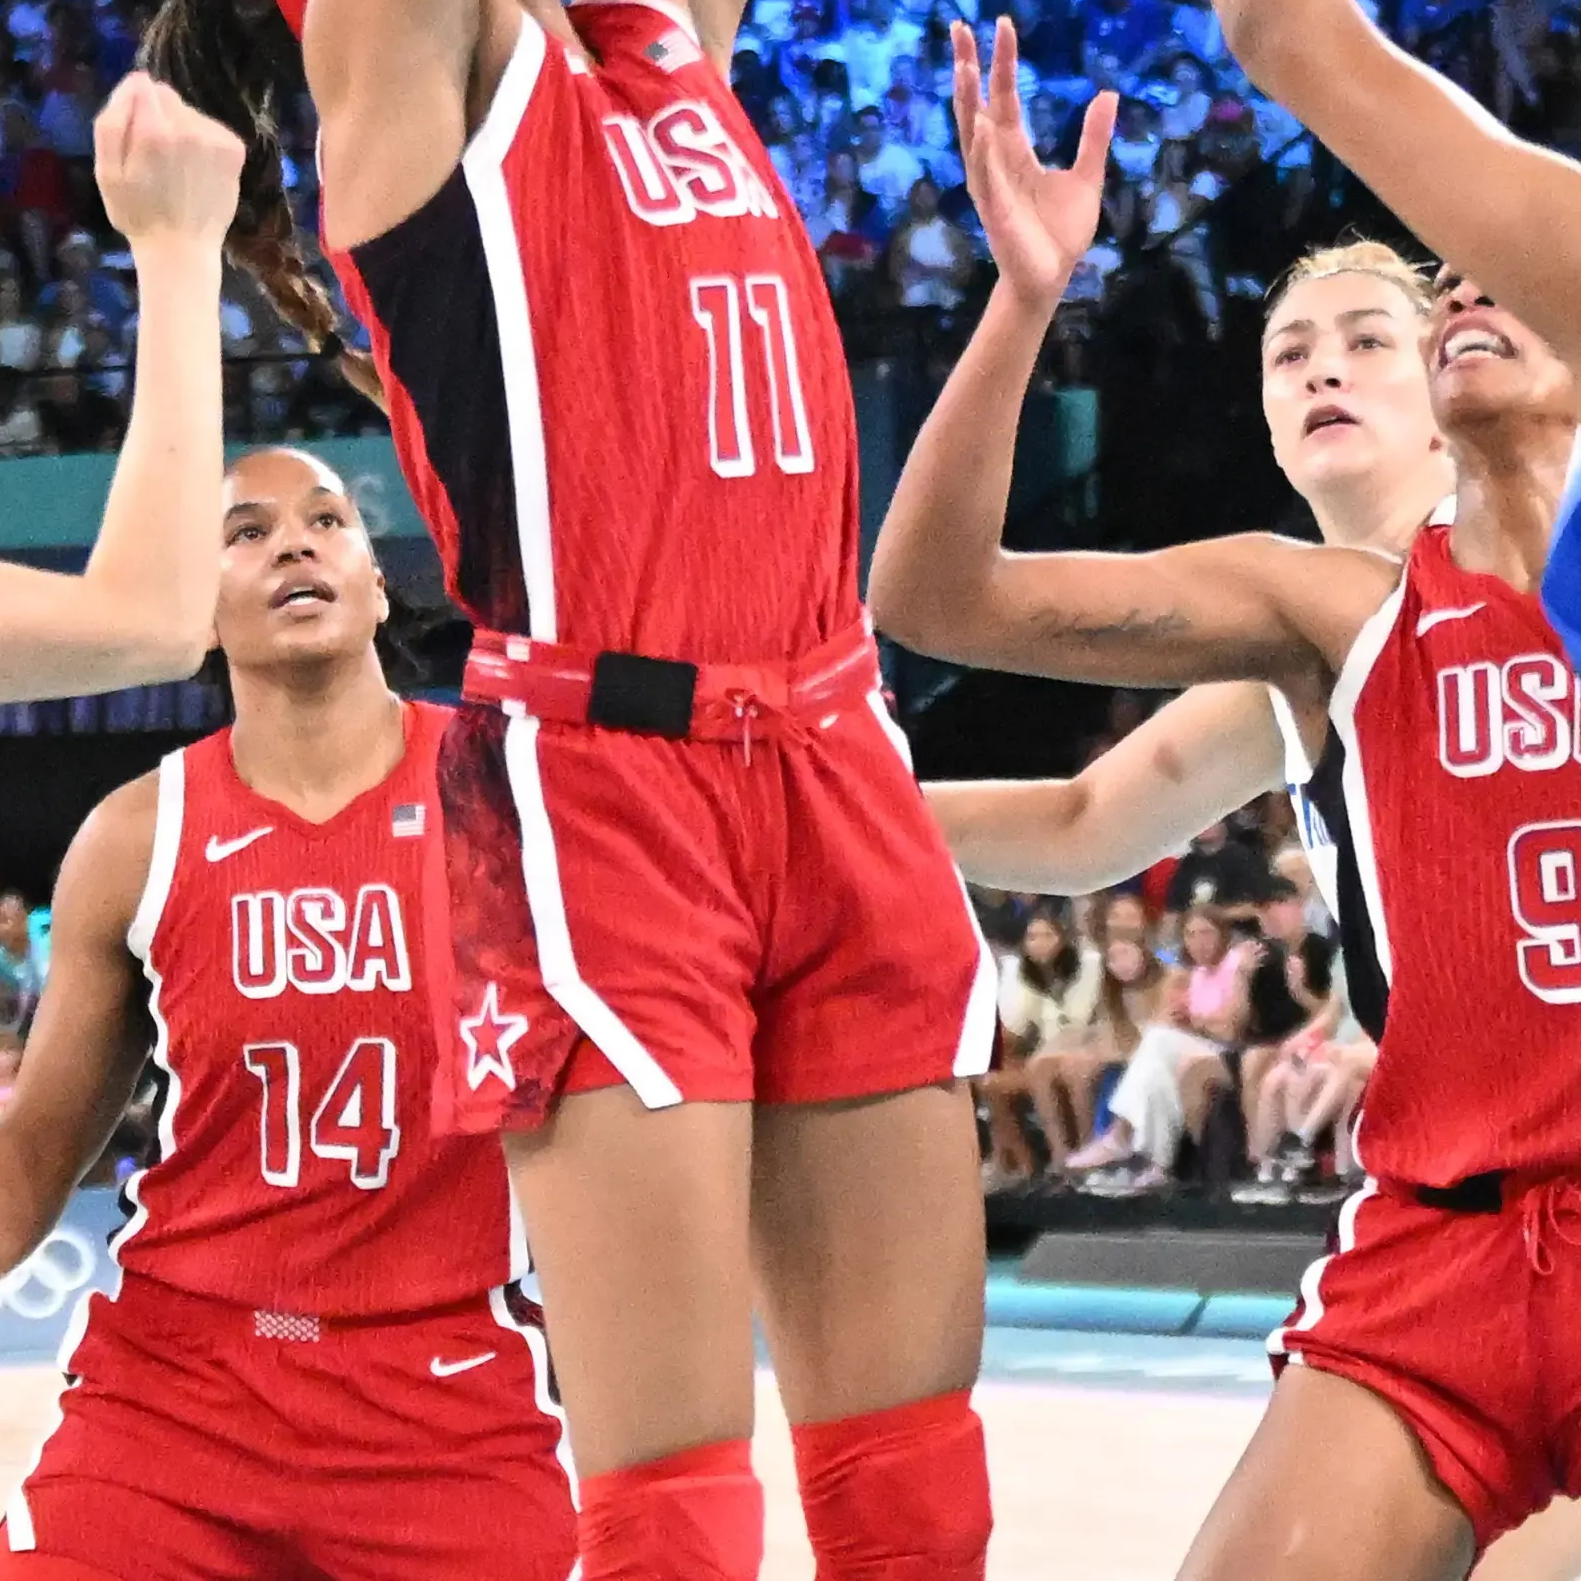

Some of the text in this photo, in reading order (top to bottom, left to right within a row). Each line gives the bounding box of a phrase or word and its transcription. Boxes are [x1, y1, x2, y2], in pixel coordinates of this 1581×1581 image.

[689, 274, 816, 479] 11
[230, 882, 412, 1001] USA
[242, 1035, 401, 1191] 14
